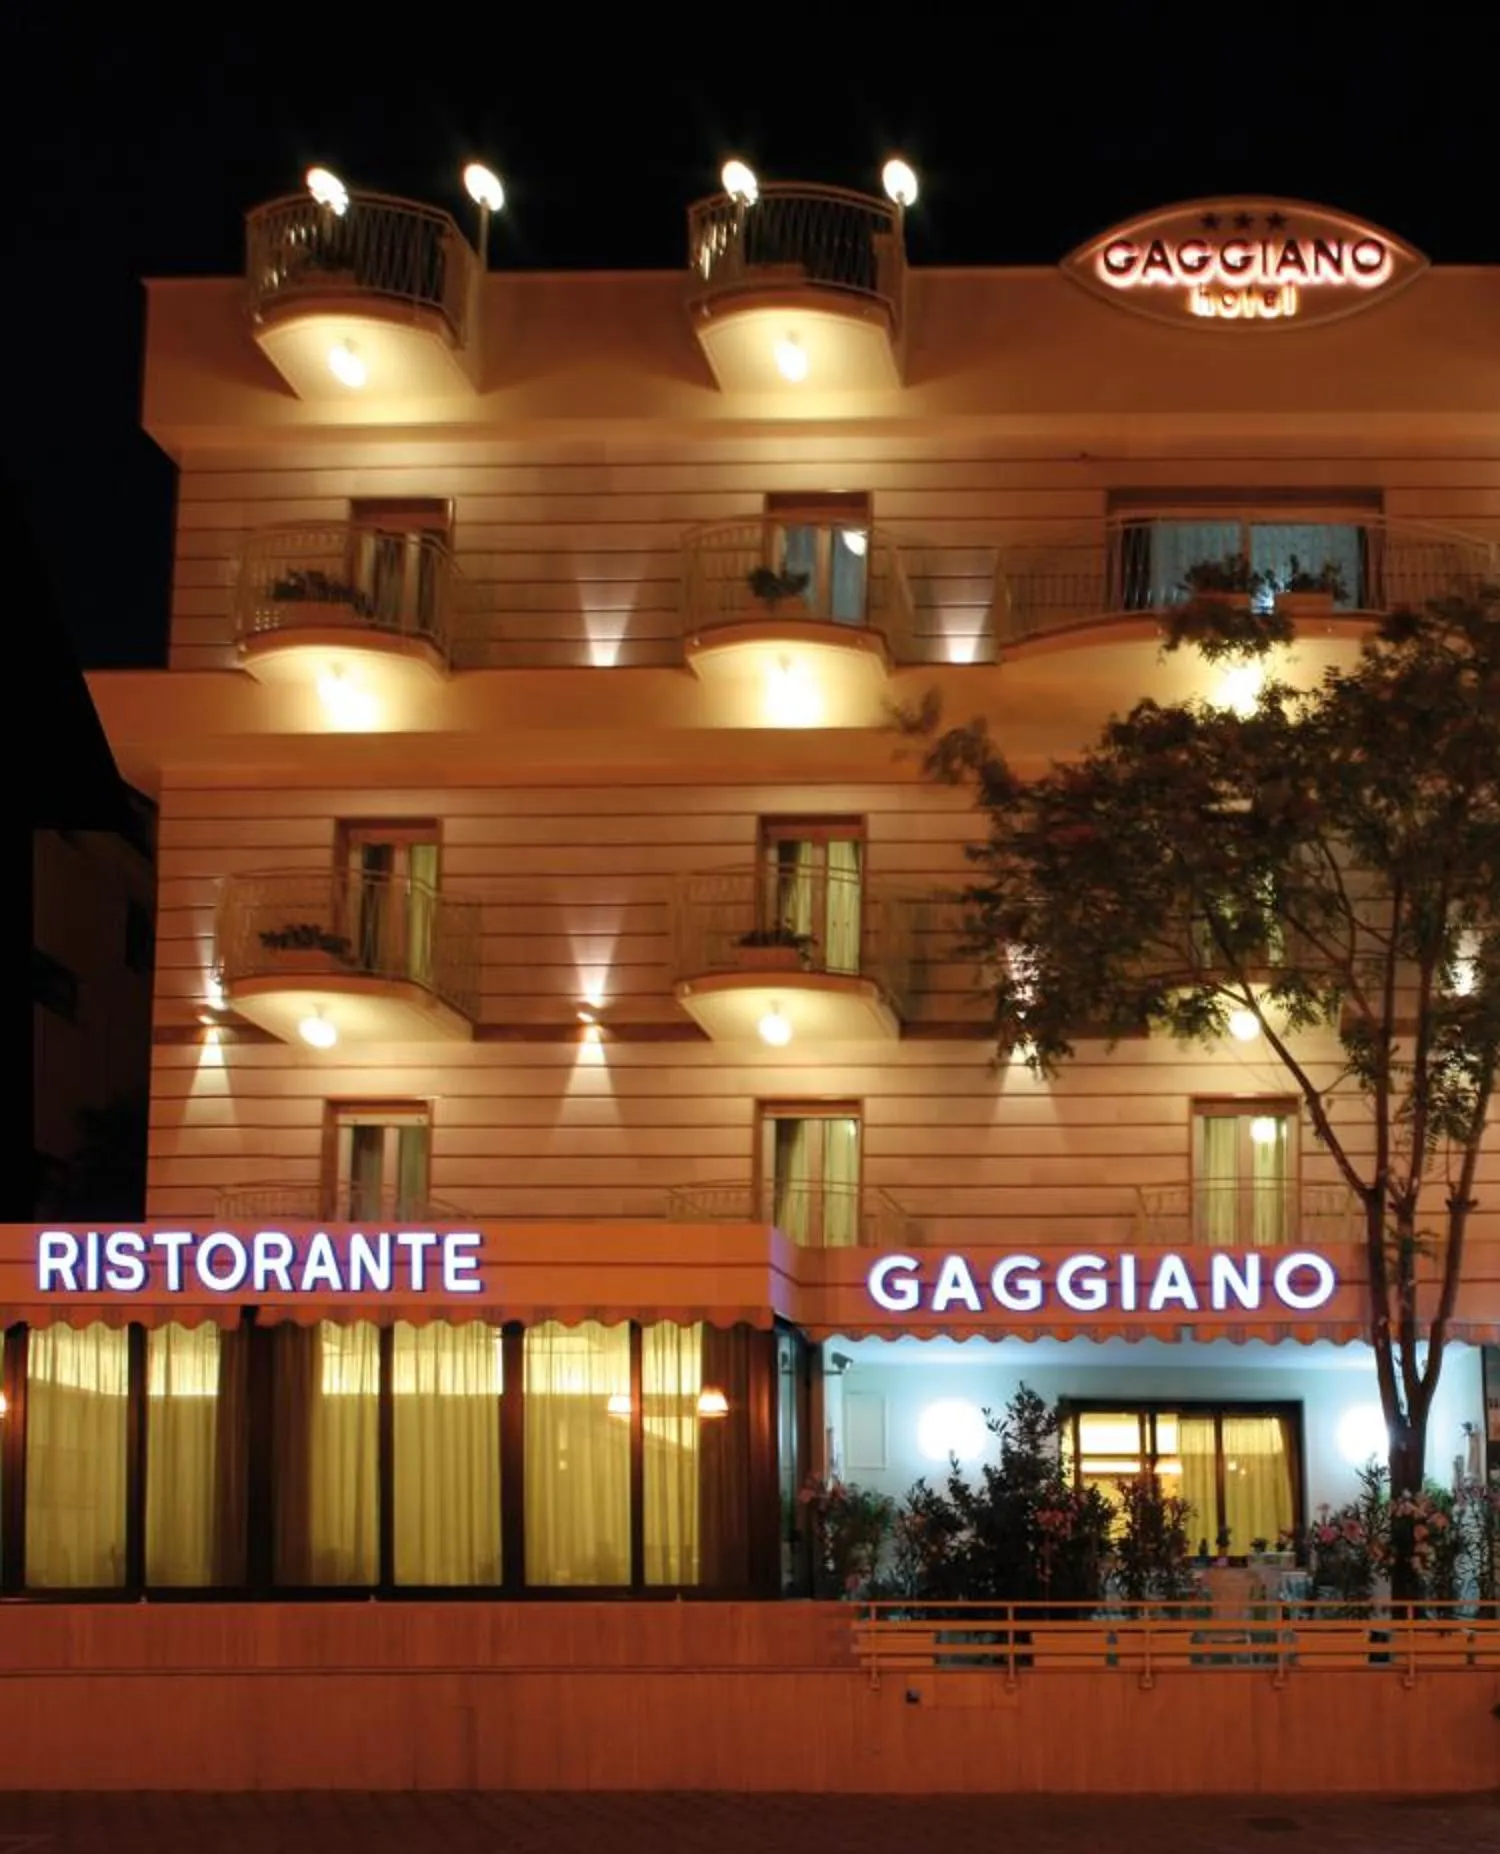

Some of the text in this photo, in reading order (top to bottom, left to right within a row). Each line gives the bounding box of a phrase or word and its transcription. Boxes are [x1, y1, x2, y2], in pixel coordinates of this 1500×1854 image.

[1100, 237, 1391, 285] GAGGIANO
[37, 1231, 483, 1292] RISTORANTE
[867, 1252, 1336, 1313] GAGGIANO
